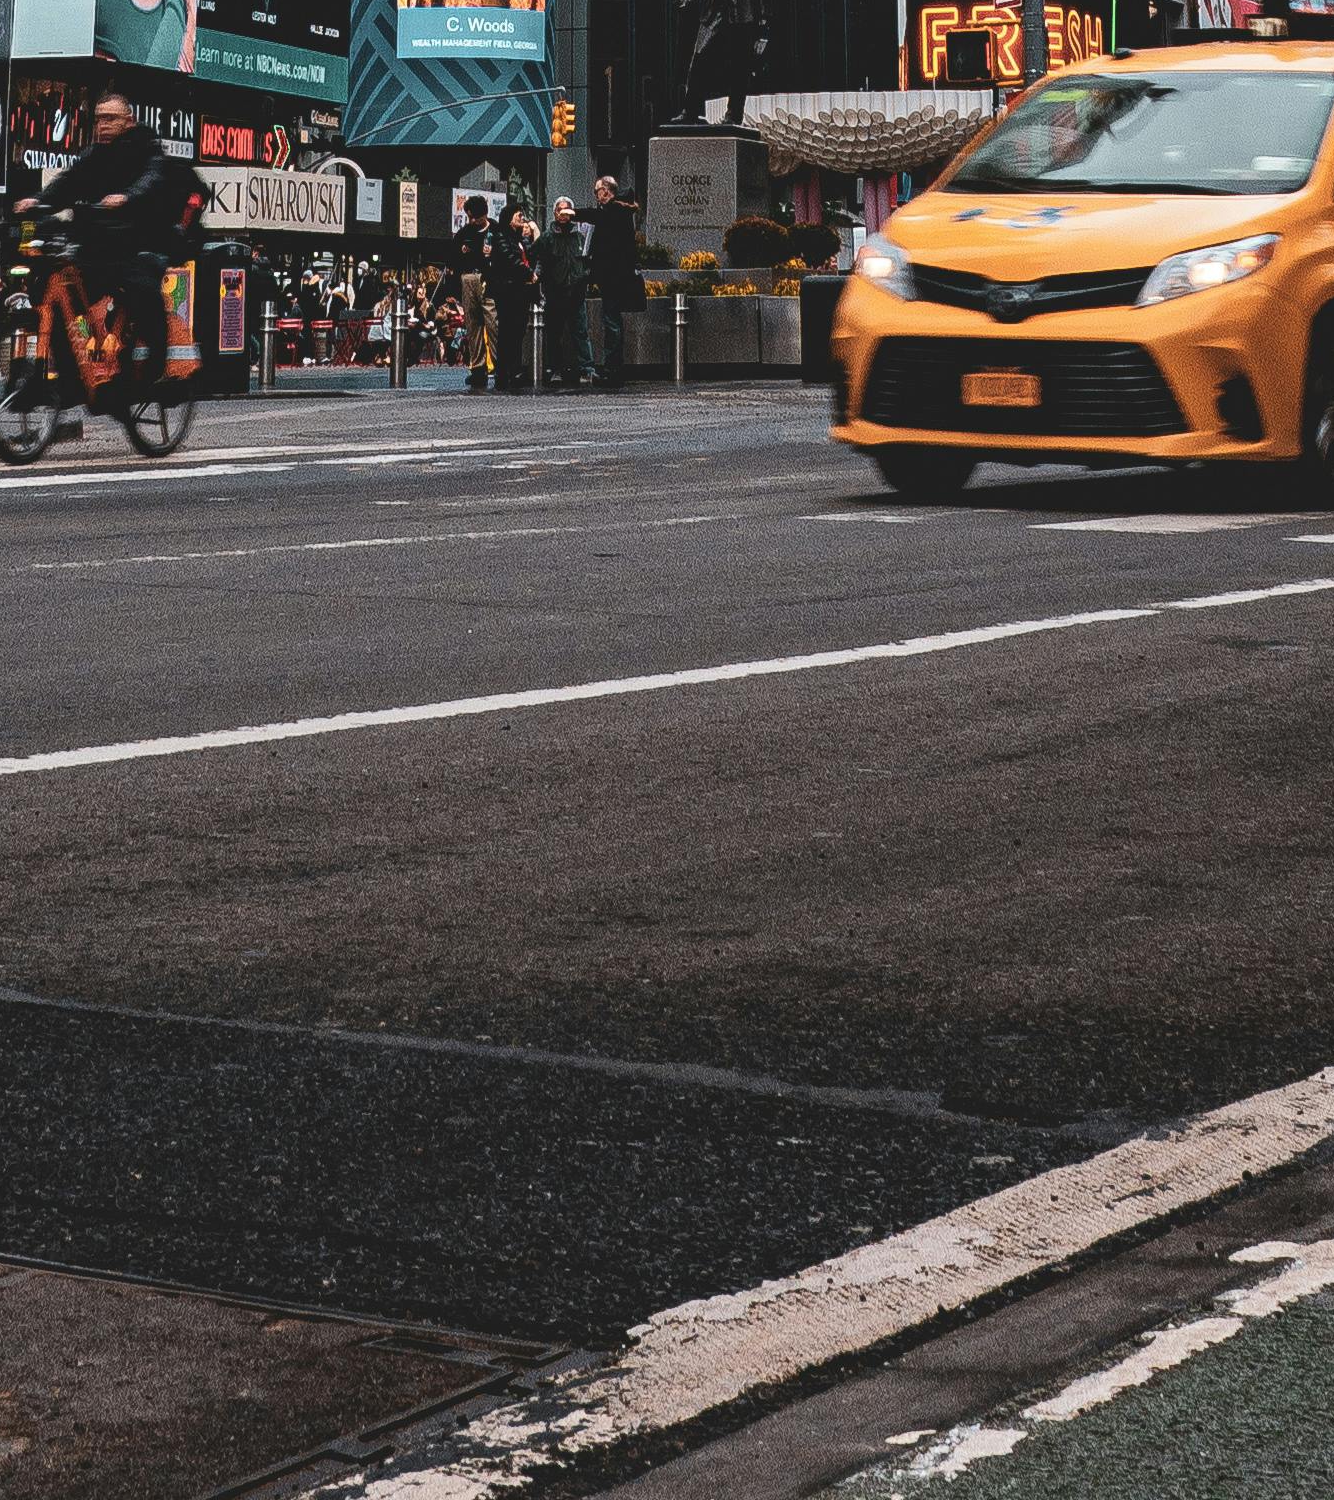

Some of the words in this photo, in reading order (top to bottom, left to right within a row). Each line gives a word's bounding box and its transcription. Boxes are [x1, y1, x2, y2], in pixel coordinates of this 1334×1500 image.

[446, 17, 464, 32] C.
[468, 17, 515, 34] Woods
[922, 4, 1103, 79] FRESH
[196, 42, 220, 63] Learn
[223, 51, 242, 68] more
[244, 55, 254, 71] at
[257, 55, 326, 84] NBCNews.com/NOW
[170, 109, 194, 139] FIN
[170, 143, 193, 158] SUSHI
[202, 124, 224, 157] DOS
[671, 174, 712, 186] GEORGE
[248, 174, 345, 227] SWAROVSKI
[674, 195, 710, 207] COHAN
